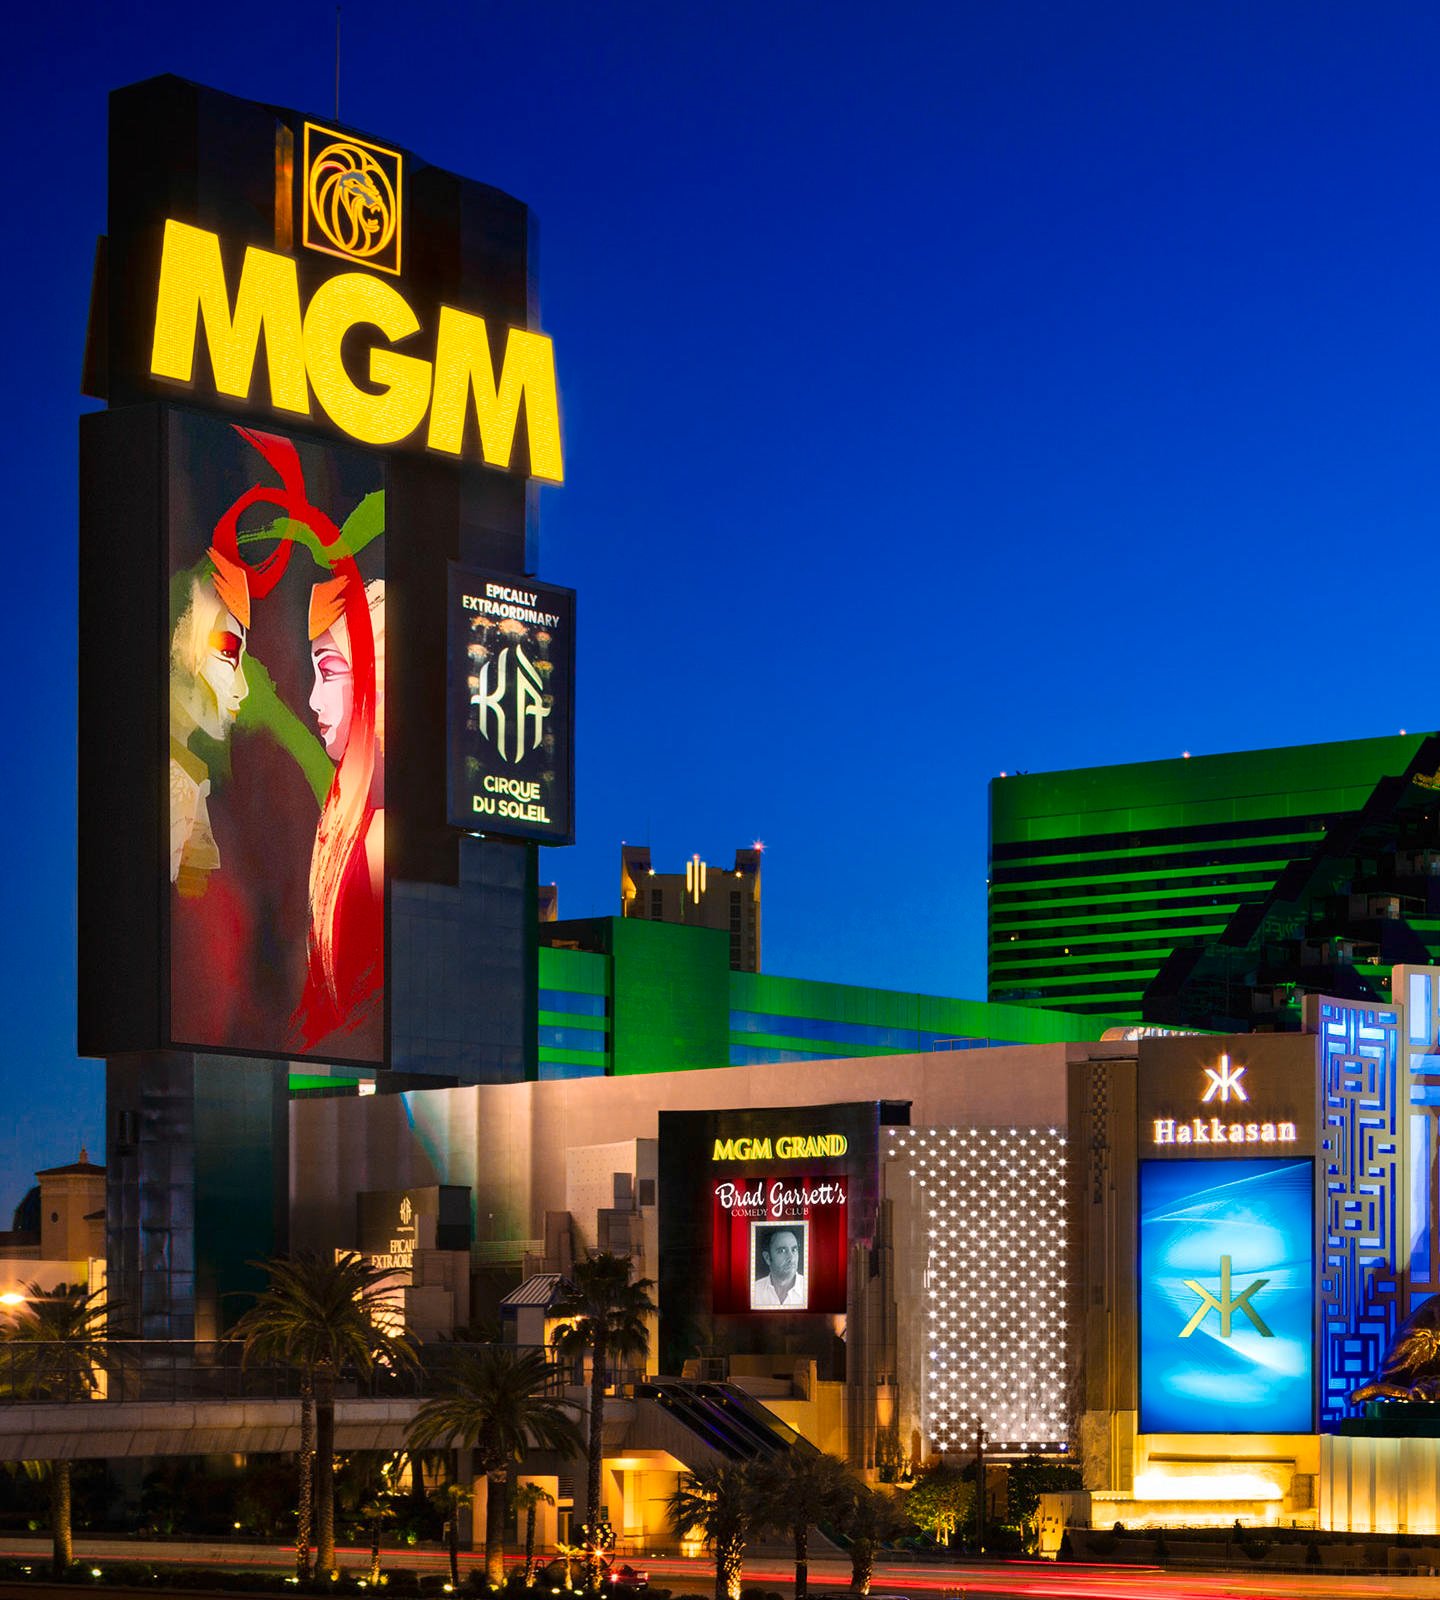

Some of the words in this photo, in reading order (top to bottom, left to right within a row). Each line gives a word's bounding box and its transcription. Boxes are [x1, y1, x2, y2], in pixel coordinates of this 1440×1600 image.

[150, 218, 564, 482] MGM
[486, 583, 538, 607] EPICALLY
[462, 595, 560, 628] EXTRAORDINARY
[483, 775, 541, 803] CIRQUE
[472, 795, 496, 814] DU
[498, 801, 551, 824] SOLEIL
[1153, 1117, 1298, 1144] Hakkasan
[712, 1138, 773, 1160] MGM
[775, 1134, 848, 1159] GRAND
[715, 1181, 765, 1209] Brad
[769, 1181, 847, 1217] Garrett's
[731, 1207, 769, 1217] COMEDY
[785, 1207, 809, 1216] CLUB
